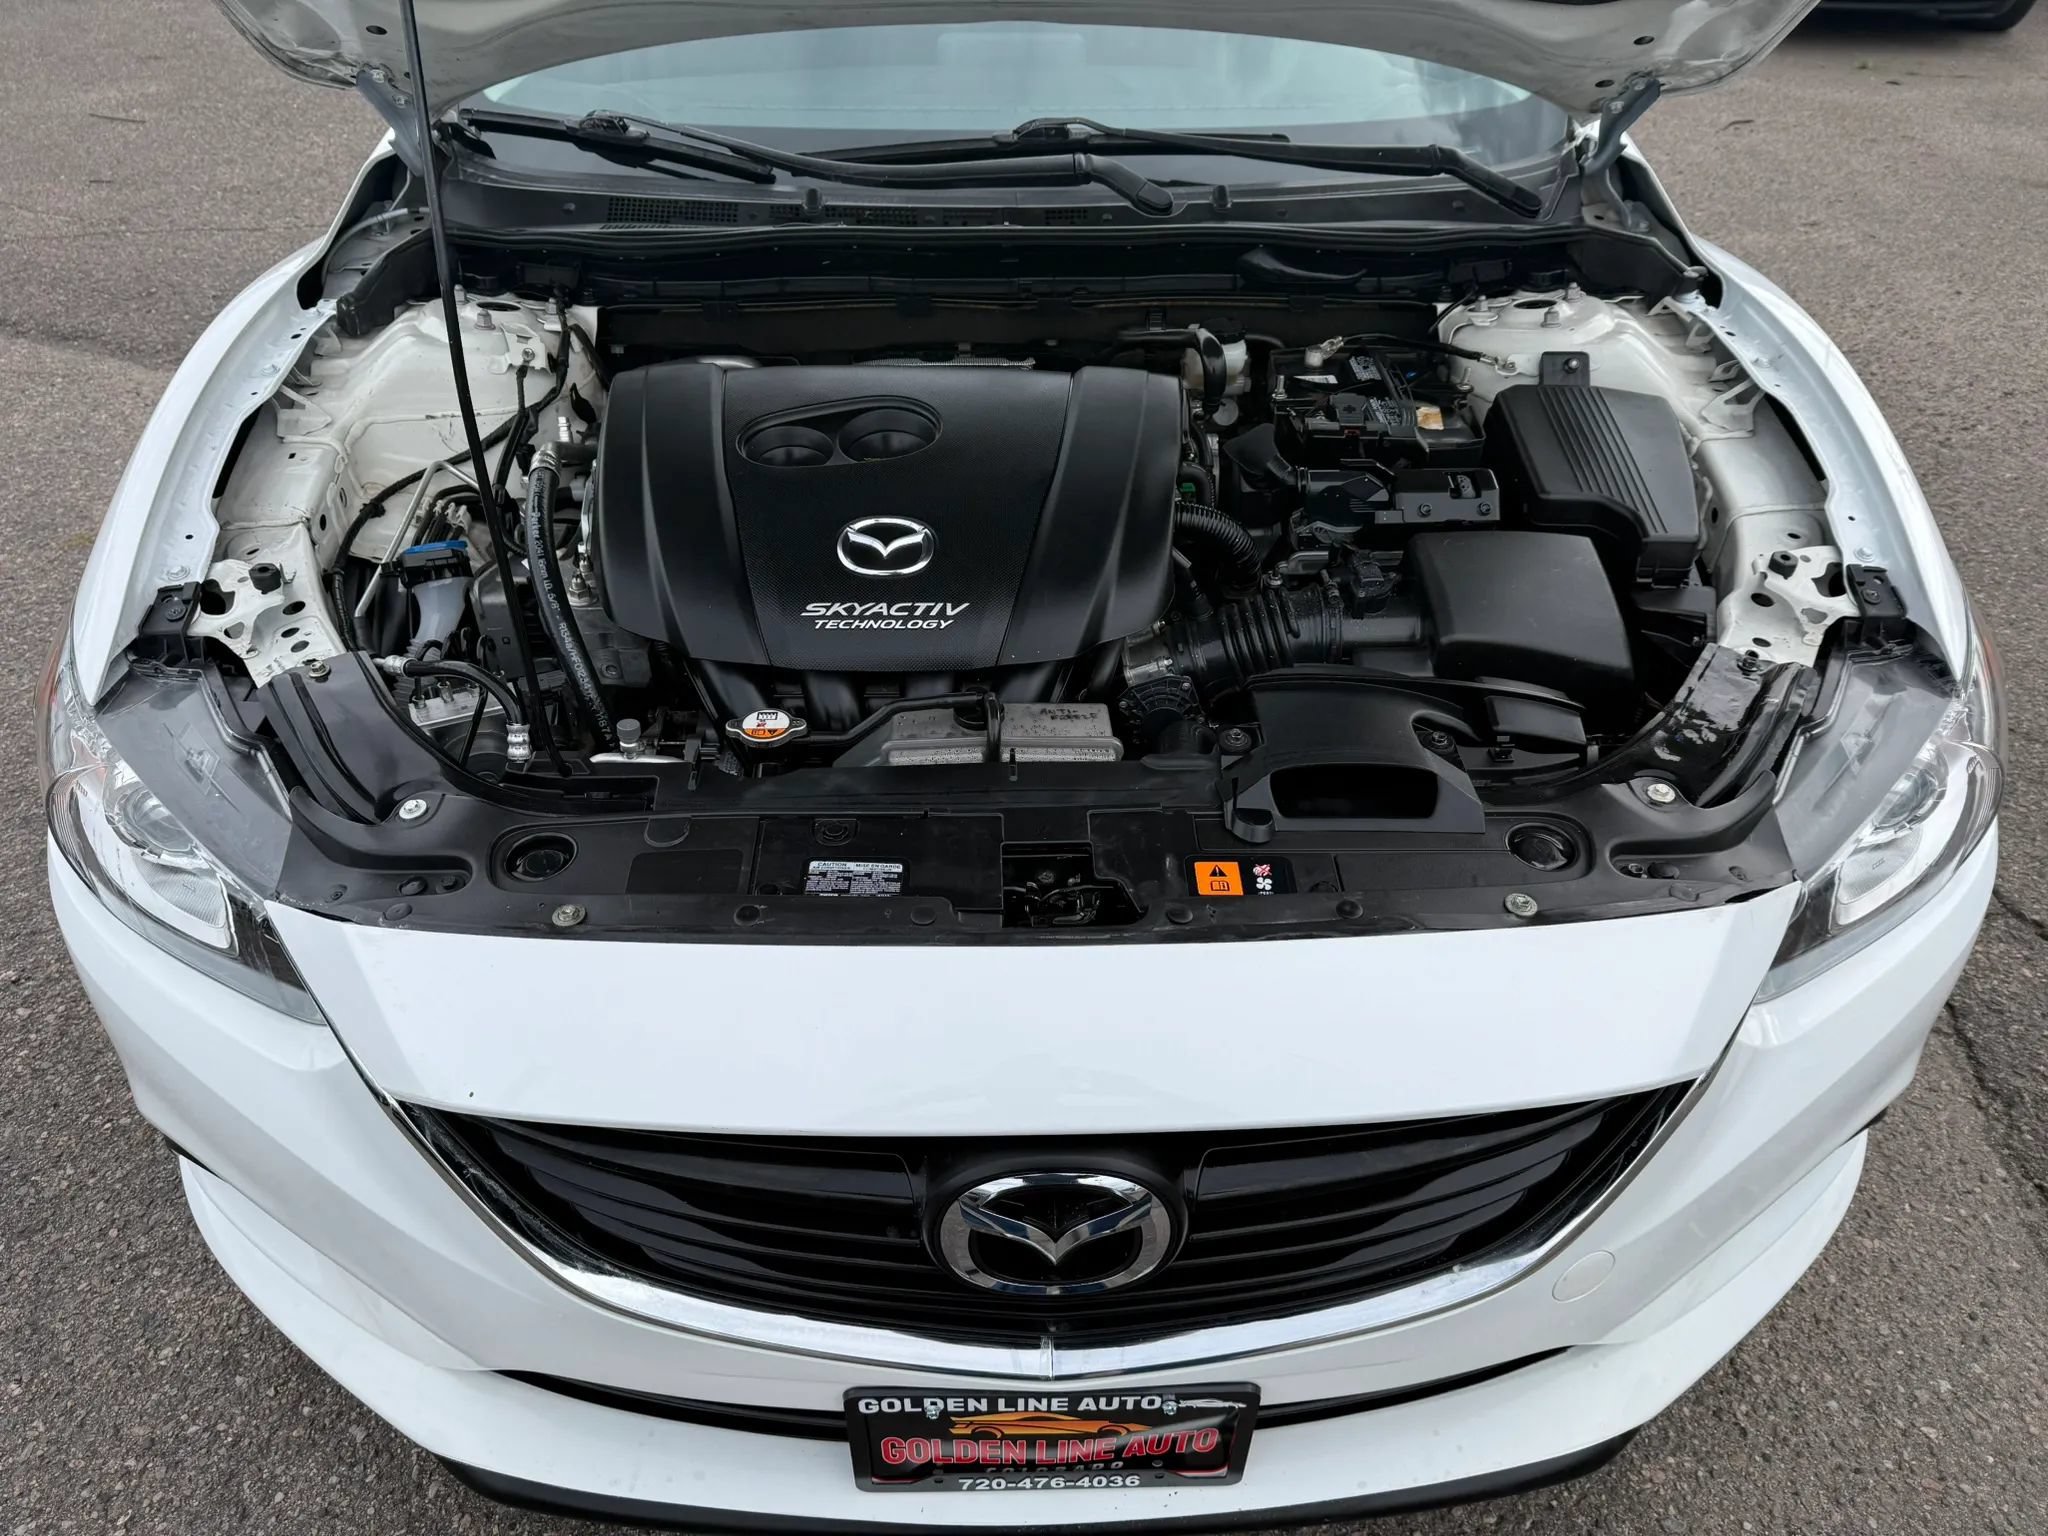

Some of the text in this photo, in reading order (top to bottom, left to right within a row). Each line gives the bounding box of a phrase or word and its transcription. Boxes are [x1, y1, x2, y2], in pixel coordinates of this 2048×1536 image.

[531, 512, 541, 538] Parker
[801, 602, 970, 616] SKYACTIV
[814, 619, 953, 629] TECHNOLOGY
[858, 1395, 1162, 1414] GOLDEN LINE AUTO
[880, 1427, 1220, 1465] GOLDEN LINE AUTO
[958, 1474, 1141, 1491] 720-476-4036
